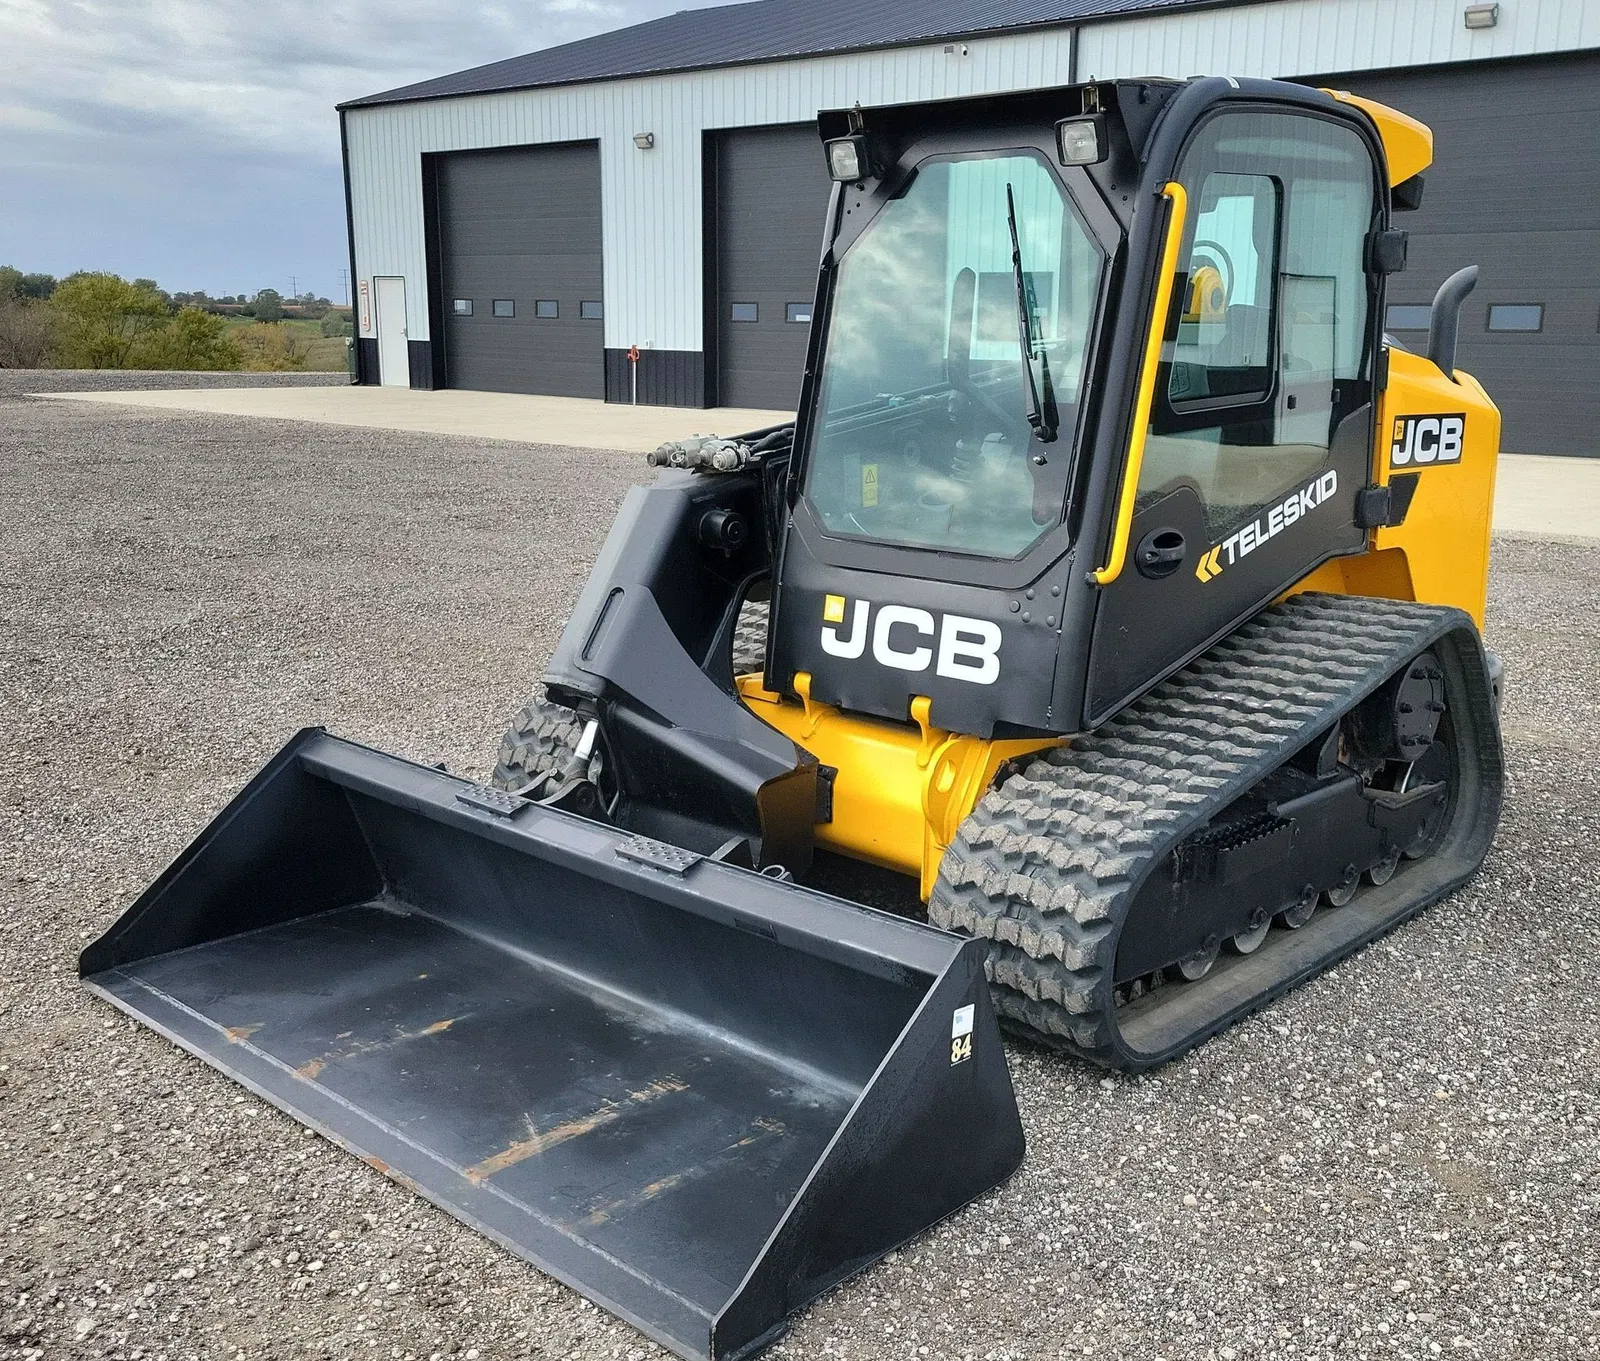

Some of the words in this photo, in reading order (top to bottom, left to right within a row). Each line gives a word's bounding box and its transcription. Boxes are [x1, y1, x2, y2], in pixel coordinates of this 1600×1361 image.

[1392, 417, 1463, 465] JCB
[1222, 469, 1338, 565] TELESKID
[820, 598, 1003, 685] JCB
[951, 1033, 972, 1063] 84
